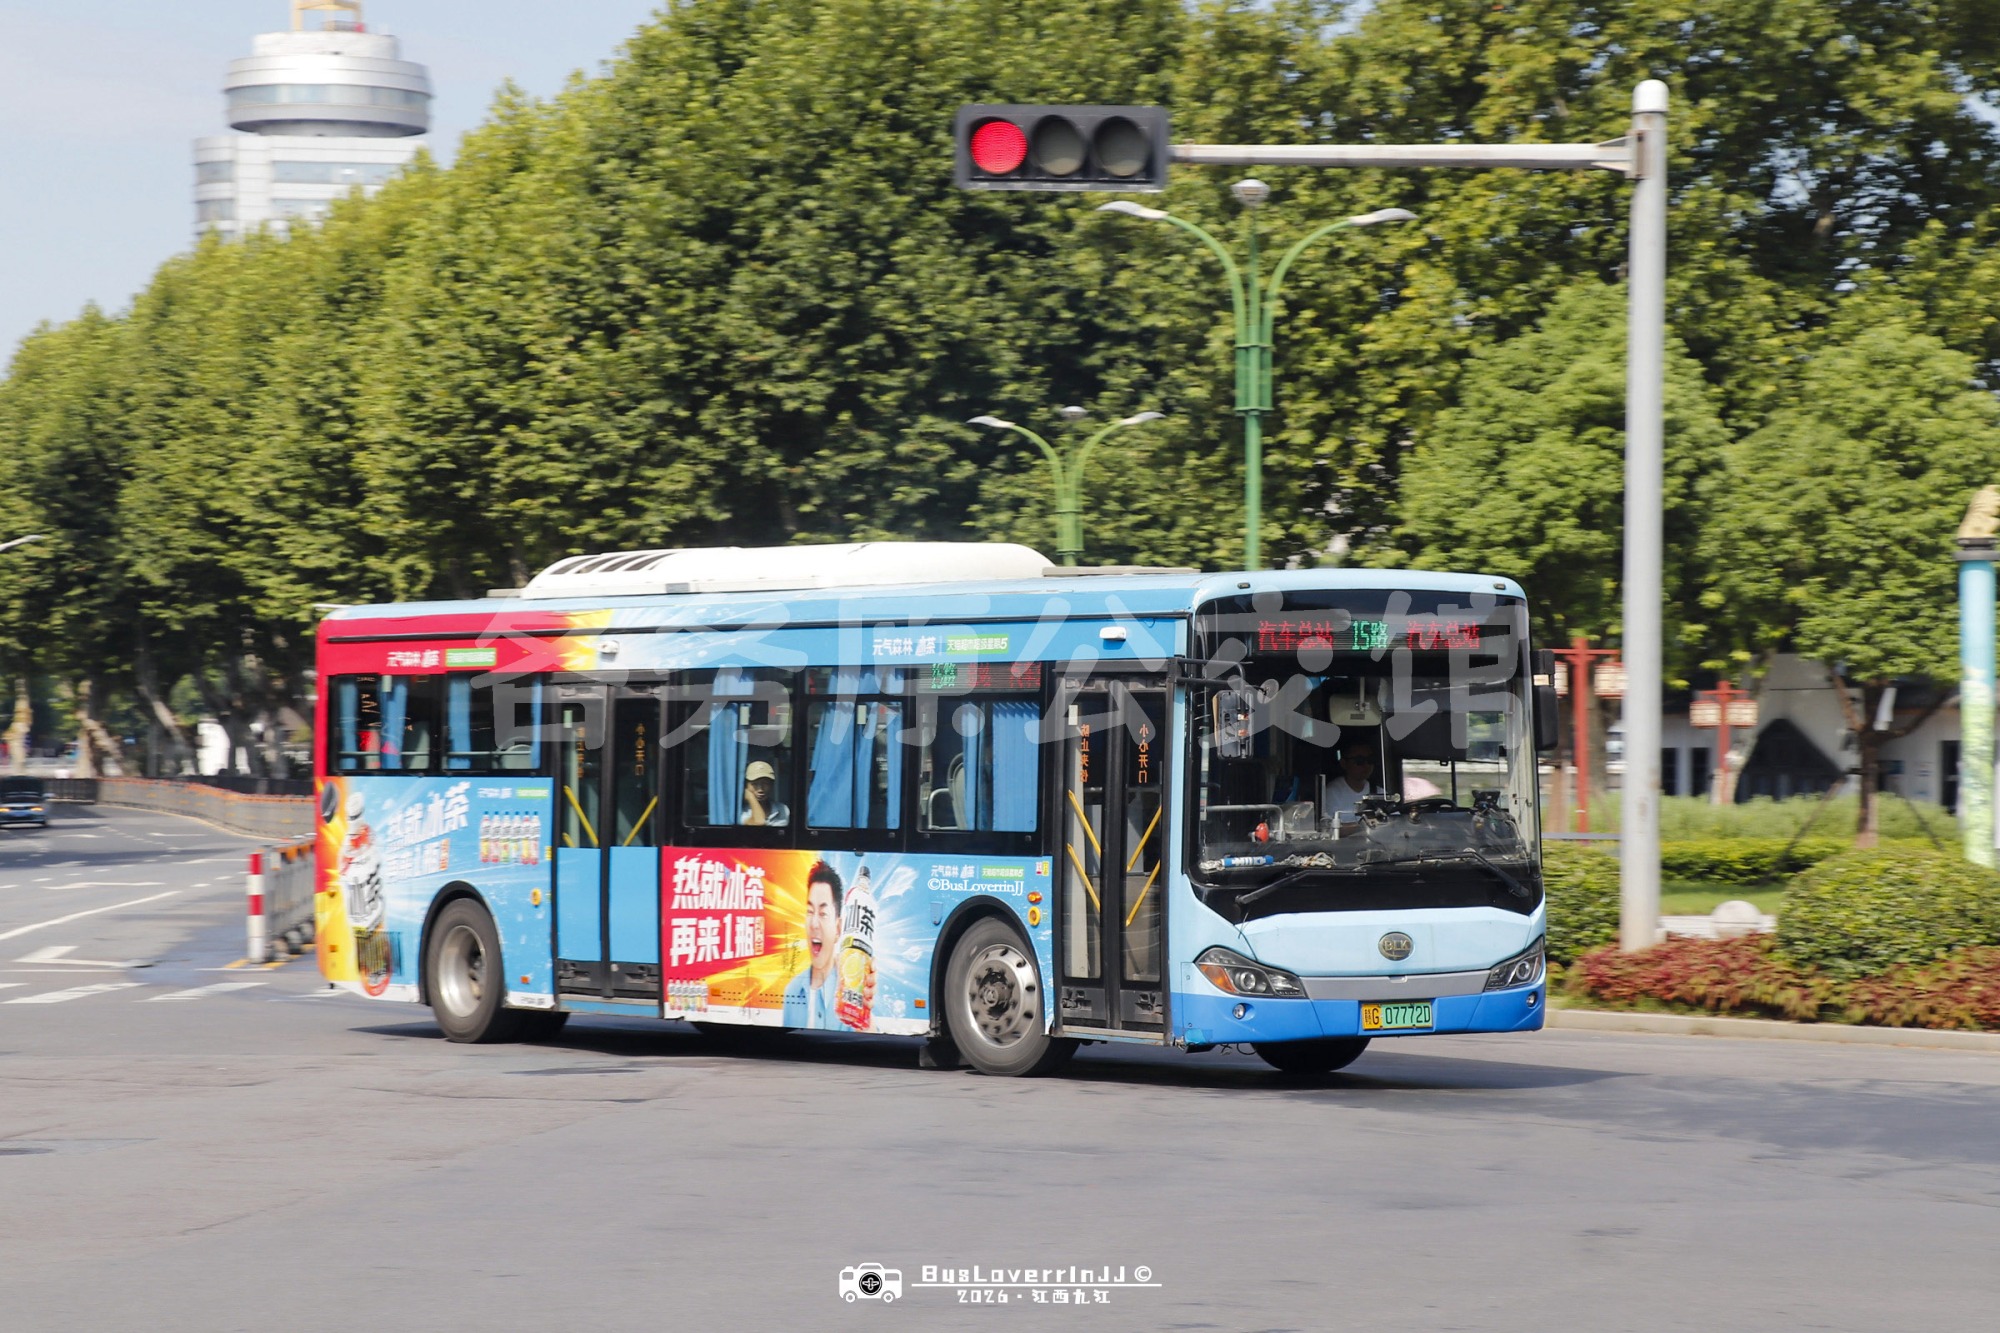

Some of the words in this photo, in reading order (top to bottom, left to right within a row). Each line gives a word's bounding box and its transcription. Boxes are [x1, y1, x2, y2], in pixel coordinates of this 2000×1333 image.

[872, 637, 913, 656] 元气森林
[1258, 620, 1334, 650] 汽车总站
[1352, 620, 1388, 650] 15路
[1406, 620, 1480, 650] 汽车总站
[671, 853, 766, 910] 热就冰茶
[670, 914, 756, 967] 再来1瓶
